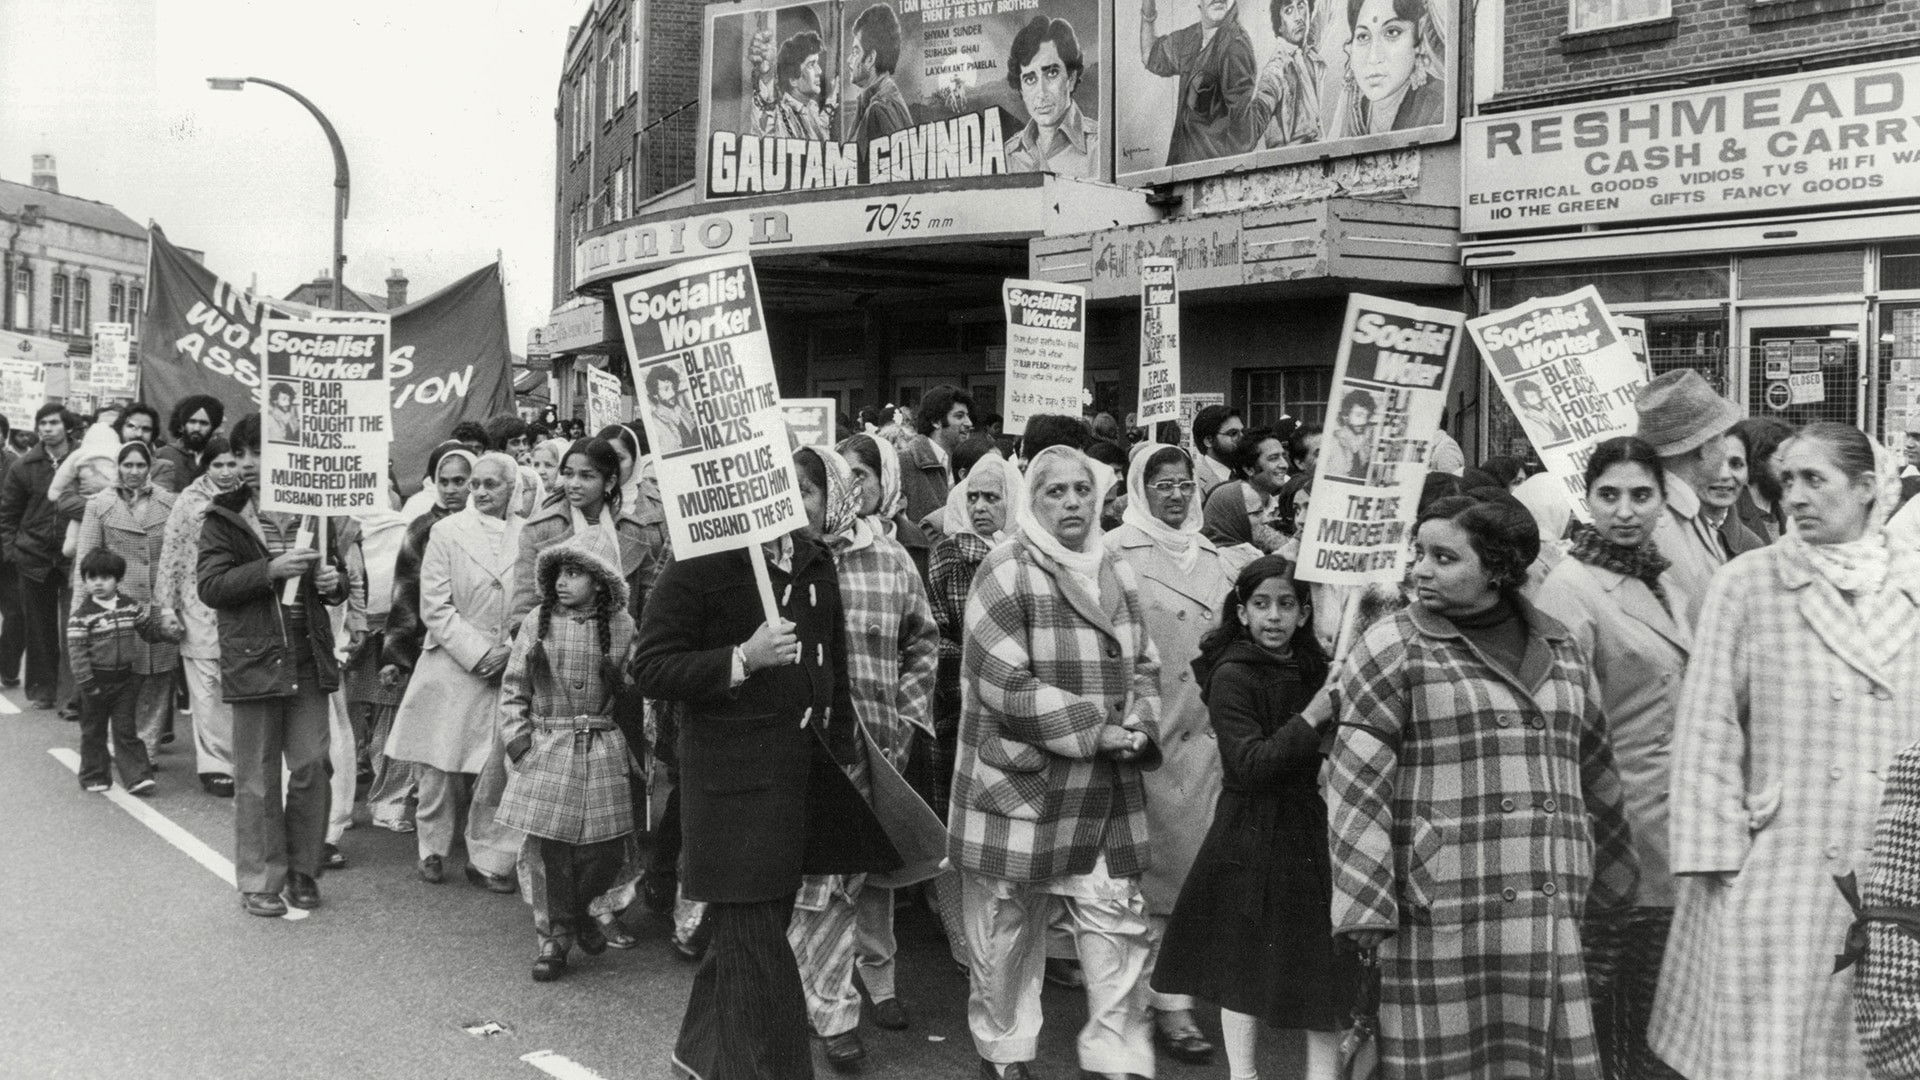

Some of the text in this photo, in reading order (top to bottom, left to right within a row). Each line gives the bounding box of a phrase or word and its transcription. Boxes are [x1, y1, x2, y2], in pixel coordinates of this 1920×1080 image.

[922, 9, 944, 23] EVEN
[944, 7, 953, 20] IF
[955, 5, 967, 18] HE
[967, 4, 977, 17] IS
[978, 1, 993, 16] MY
[997, 0, 1039, 13] BROTHER
[923, 29, 950, 41] SHYAM
[953, 24, 983, 38] SUNDER
[924, 44, 980, 58] SUBHASH GHAI
[925, 63, 965, 77] LAXMIKANT
[1486, 72, 1905, 160] RESHMEAD
[712, 106, 1007, 194] GAUTAM GOVINDA
[1584, 143, 1700, 176] CASH
[1718, 137, 1747, 163] &
[1469, 186, 1581, 205] ELECTRICAL
[1591, 176, 1659, 194] GOODS
[1680, 167, 1745, 186] VIDIOS
[1763, 160, 1809, 178] TVS
[1828, 156, 1849, 171] HI
[1855, 154, 1875, 169] FI
[1519, 202, 1551, 217] THE
[1557, 197, 1620, 214] GREEN
[1649, 190, 1706, 206] GIFTS
[1722, 183, 1791, 200] FANCY
[1802, 174, 1884, 193] GOODS
[865, 196, 955, 238] 70/35 mm
[628, 268, 746, 326] Socialist
[1009, 289, 1077, 313] Socialist
[658, 305, 752, 352] Worker
[1022, 308, 1077, 330] Worker
[1482, 303, 1591, 352] Socialist
[267, 331, 376, 358] Socialist
[682, 341, 734, 376] BLAIR
[1512, 329, 1601, 370] Worker
[288, 354, 376, 379] Worker
[1540, 357, 1587, 386] BLAIR
[1790, 374, 1821, 387] CLOSED
[302, 381, 342, 398] BLAIR
[688, 364, 746, 400] PEACH
[1549, 375, 1600, 405] PEACH
[302, 398, 347, 415] PEACH
[696, 388, 757, 427] FOUGHT
[754, 382, 777, 413] THE
[1559, 394, 1614, 424] FOUGHT
[302, 415, 383, 432] FOUGHT THE
[701, 416, 765, 450] NAZIS...
[301, 432, 356, 449] NAZIS...
[287, 453, 362, 472] THE POLICE
[691, 444, 775, 487] THE POLICE
[271, 469, 377, 490] MURDERED HIM
[677, 466, 792, 519] MURDERED HIM
[273, 489, 374, 507] DISBAND THE SPG
[688, 496, 795, 543] DISBAND THE SPG
